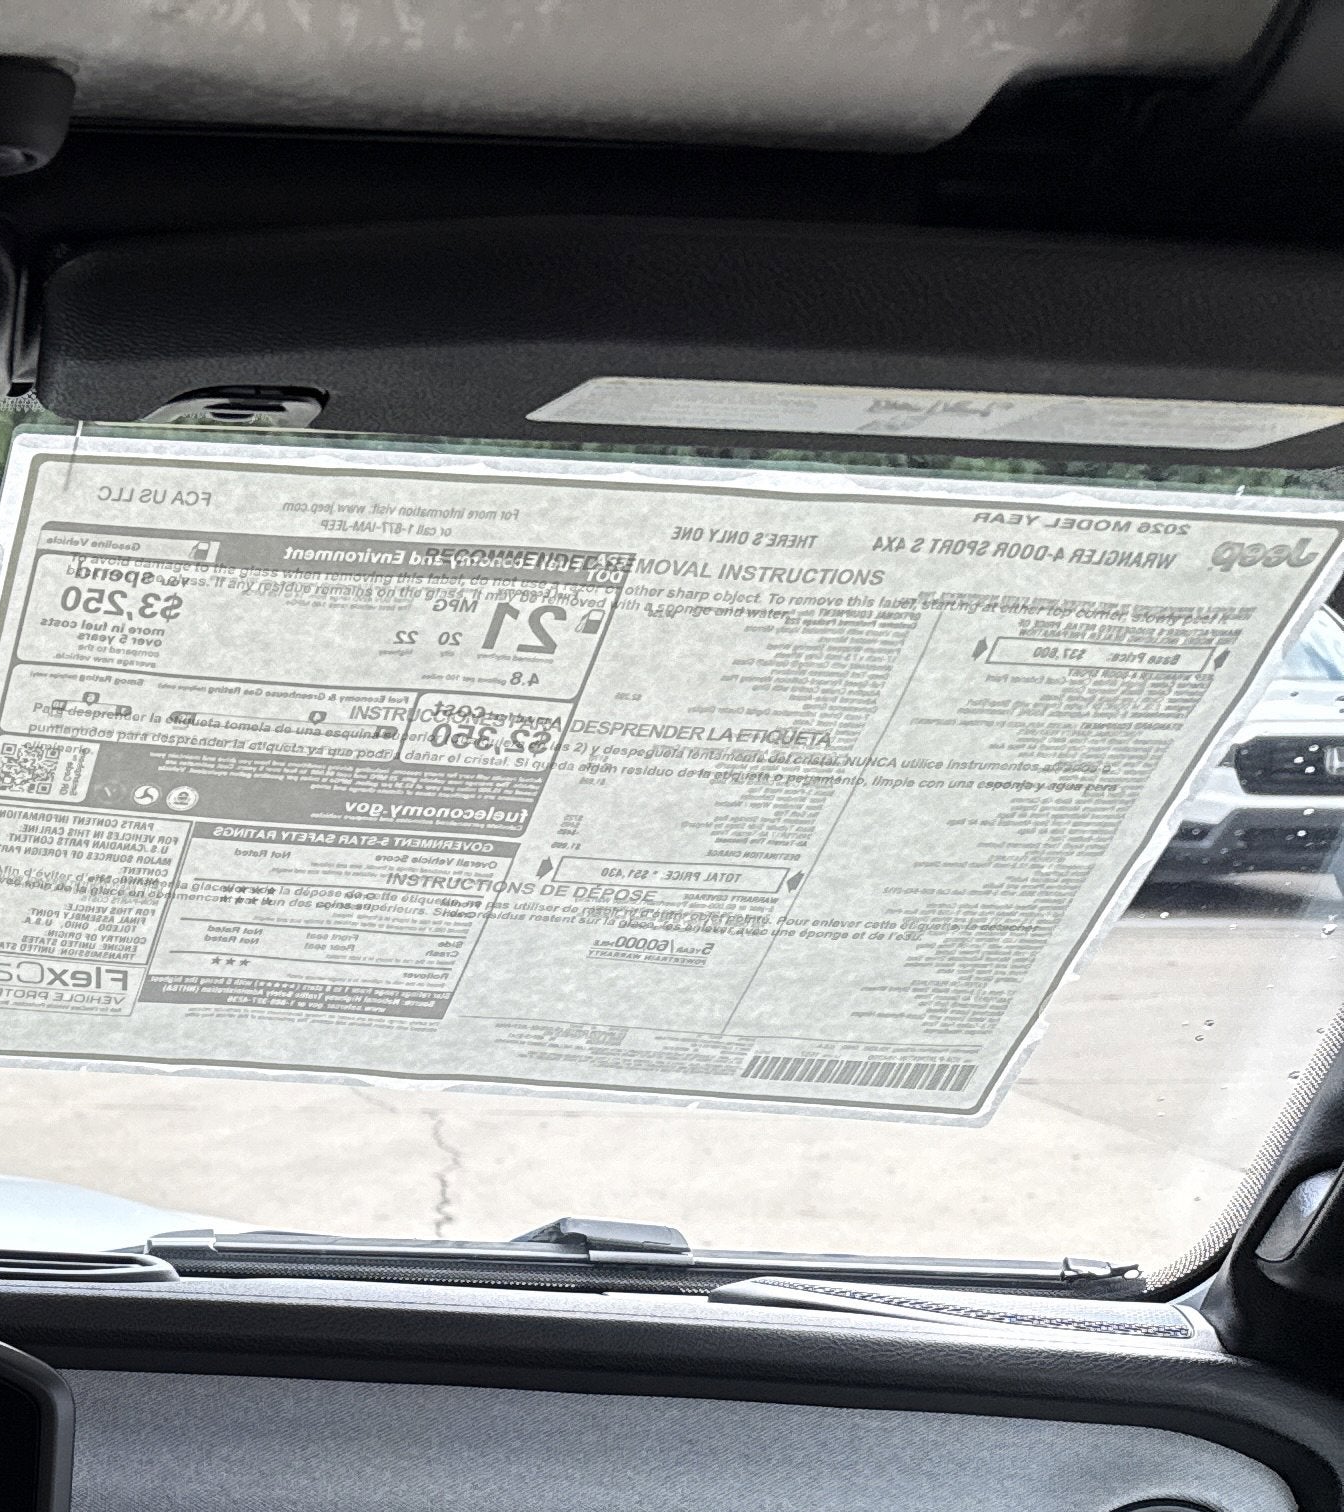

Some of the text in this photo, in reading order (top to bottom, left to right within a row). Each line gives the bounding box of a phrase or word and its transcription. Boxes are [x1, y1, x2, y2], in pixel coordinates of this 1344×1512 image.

[717, 563, 886, 586] INSTRUCTIONS
[624, 585, 875, 607] other sharp object. To remove this
[569, 719, 706, 742] DESPRENDER
[706, 727, 733, 743] LA
[736, 728, 832, 748] ETIQUETA
[845, 755, 897, 770] NUNCA
[900, 758, 943, 770] utilice
[871, 775, 973, 790] limpie con una
[385, 872, 658, 902] INSTRUCTIONS DE DÉPOSE
